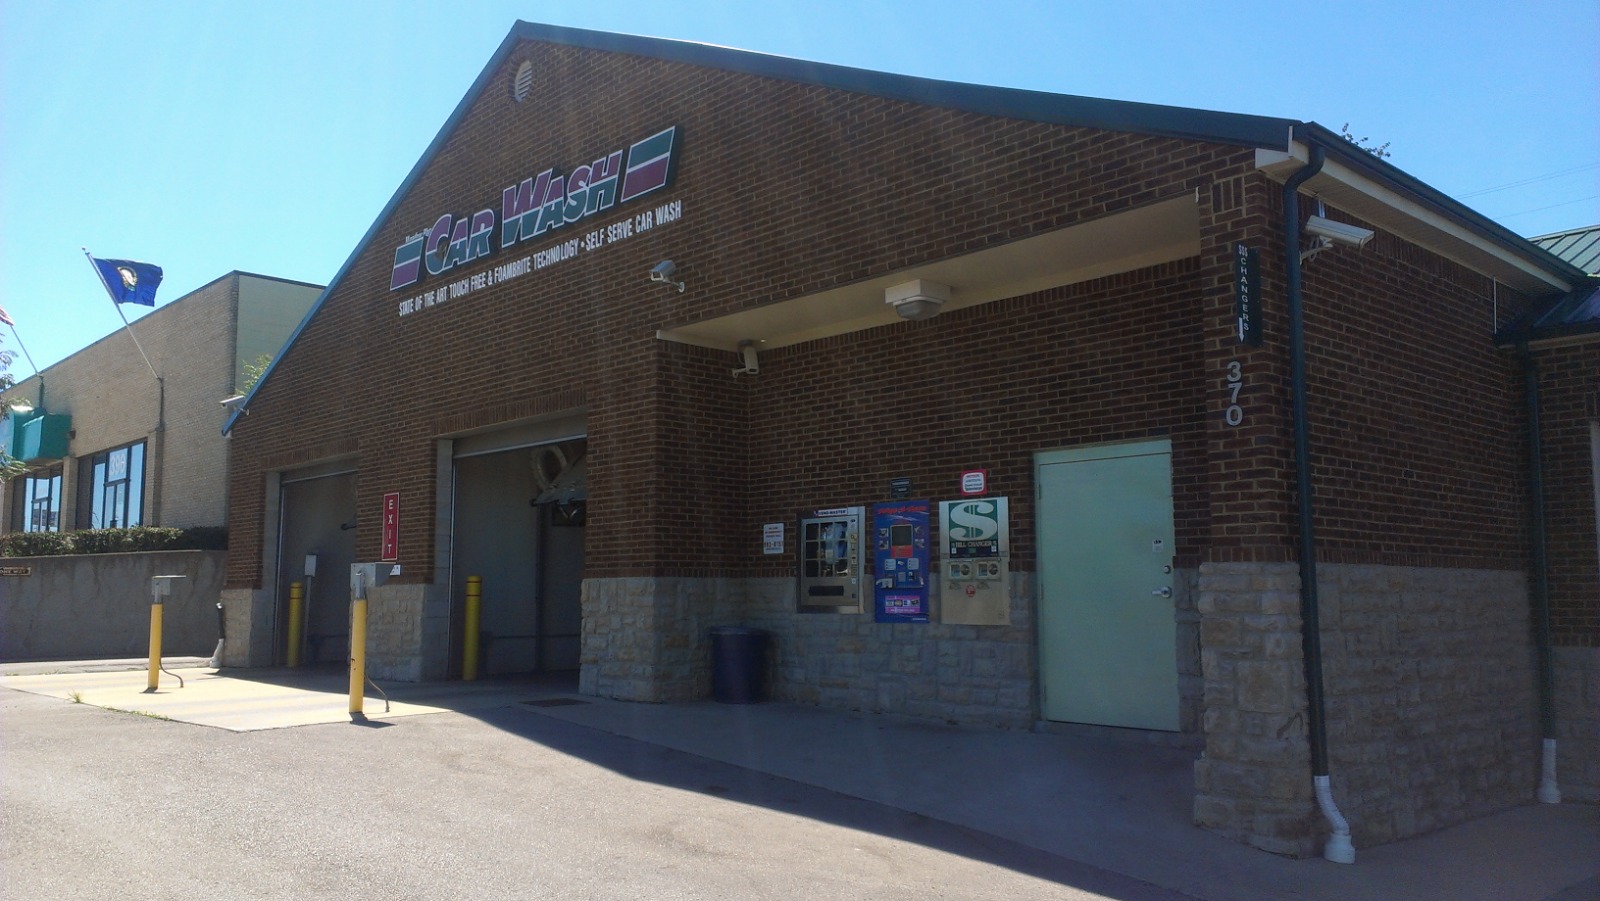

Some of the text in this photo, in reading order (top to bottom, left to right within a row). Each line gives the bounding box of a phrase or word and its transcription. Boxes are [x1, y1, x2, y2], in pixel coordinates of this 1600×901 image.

[398, 200, 682, 317] STATE OF THE ART TOUCH FREE & FOAMBRITE TECHNOLOGY SELF SERVE CAR WASH
[426, 149, 624, 275] CAR WASH
[1240, 257, 1249, 331] CHANGERS
[1226, 361, 1243, 426] 370
